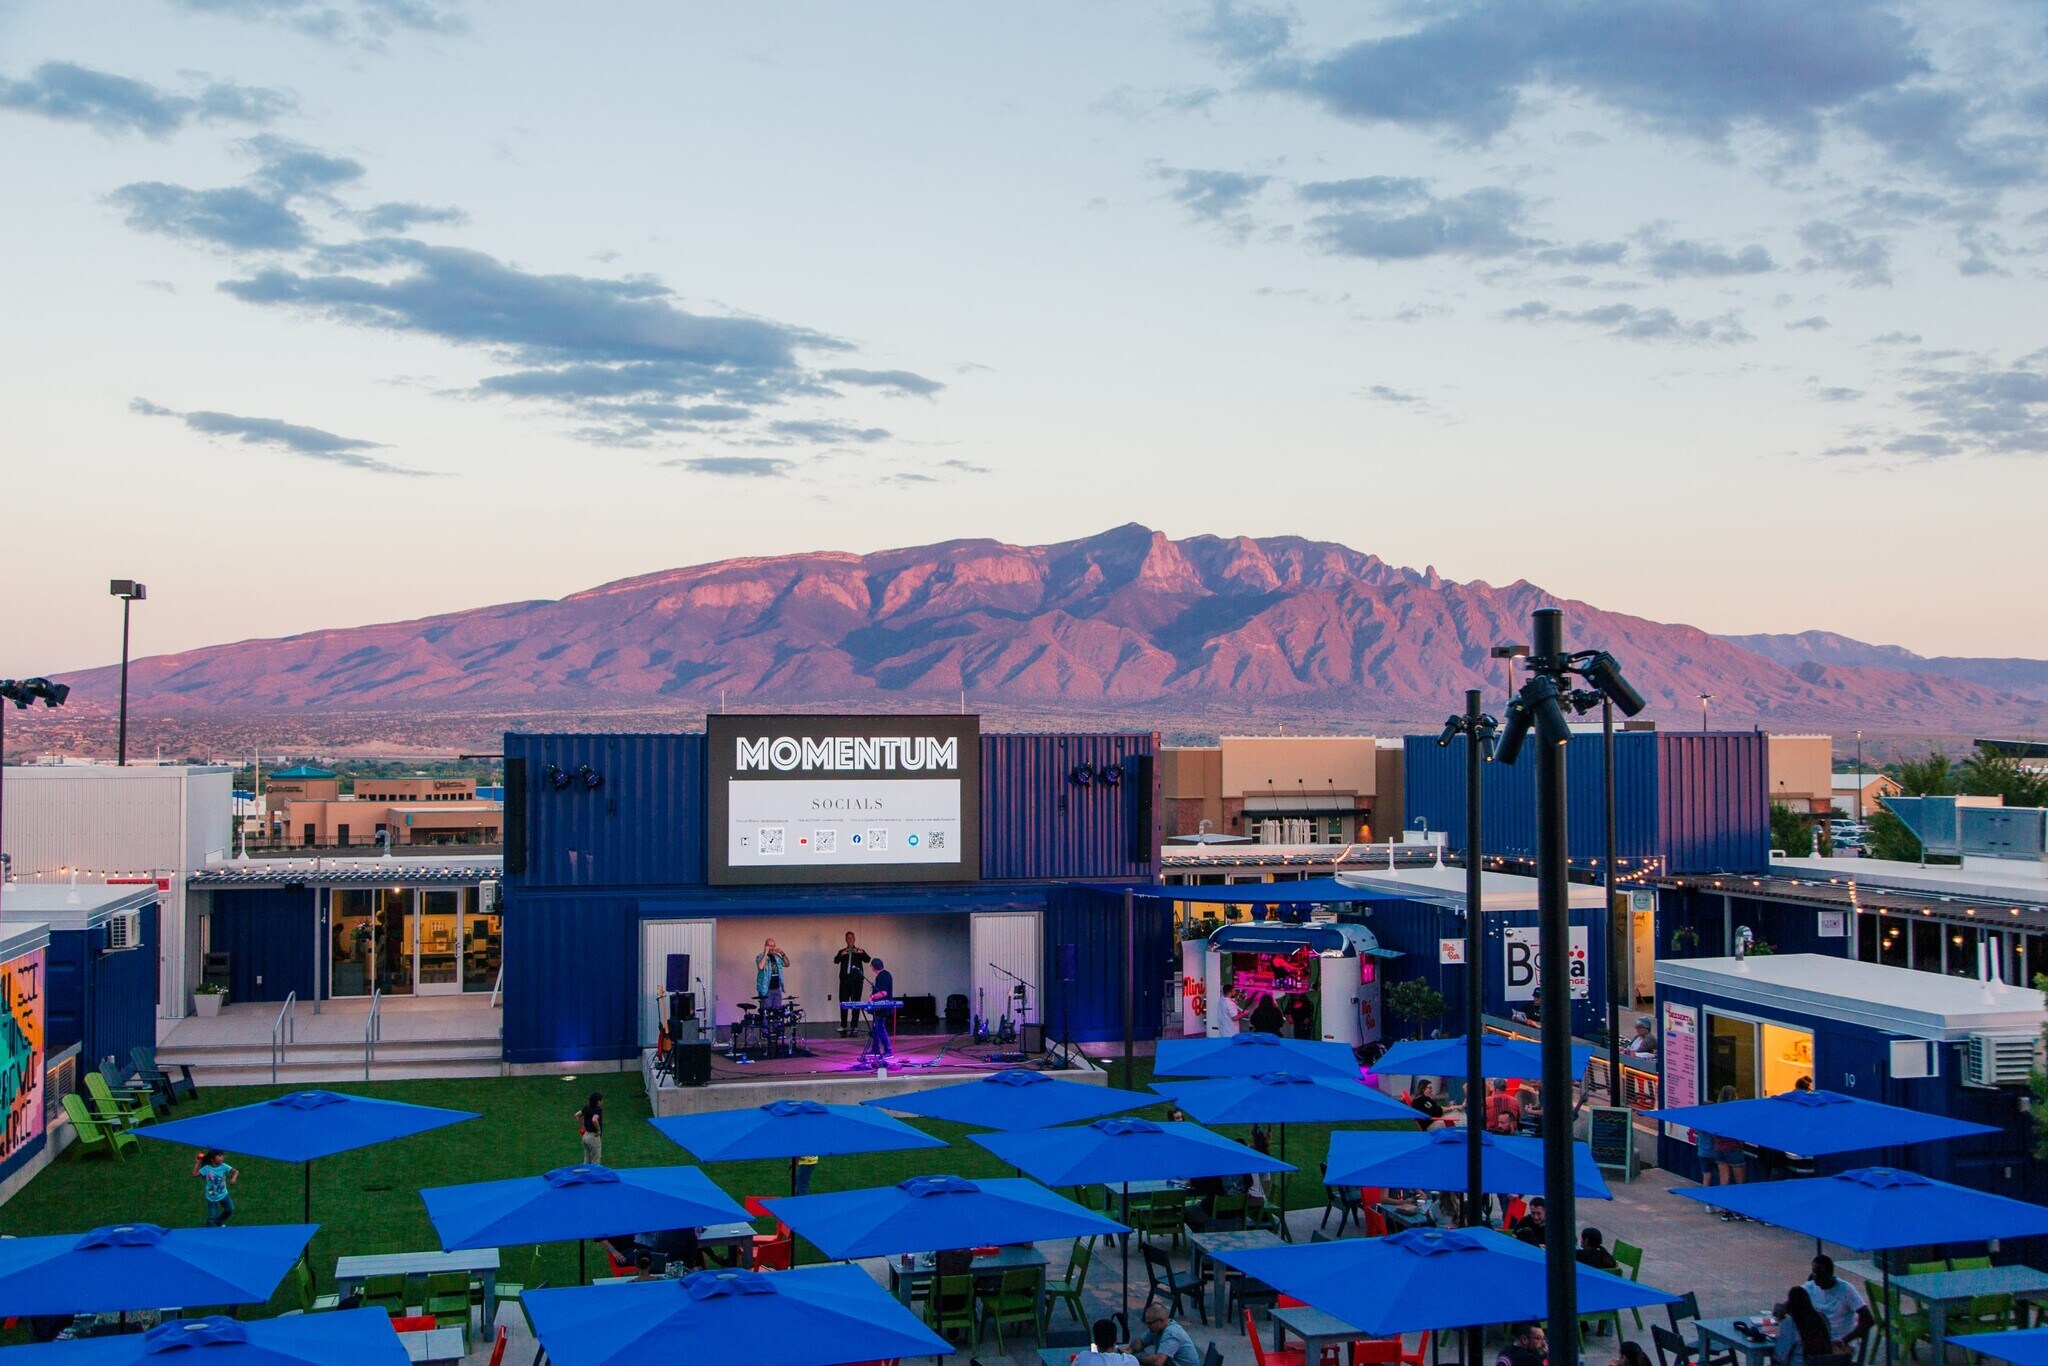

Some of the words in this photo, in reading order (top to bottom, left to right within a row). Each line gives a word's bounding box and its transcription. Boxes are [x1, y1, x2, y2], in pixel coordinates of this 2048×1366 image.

[736, 736, 958, 771] MOMENTUM
[811, 797, 884, 811] SOCIALS
[1844, 1072, 1856, 1087] 19
